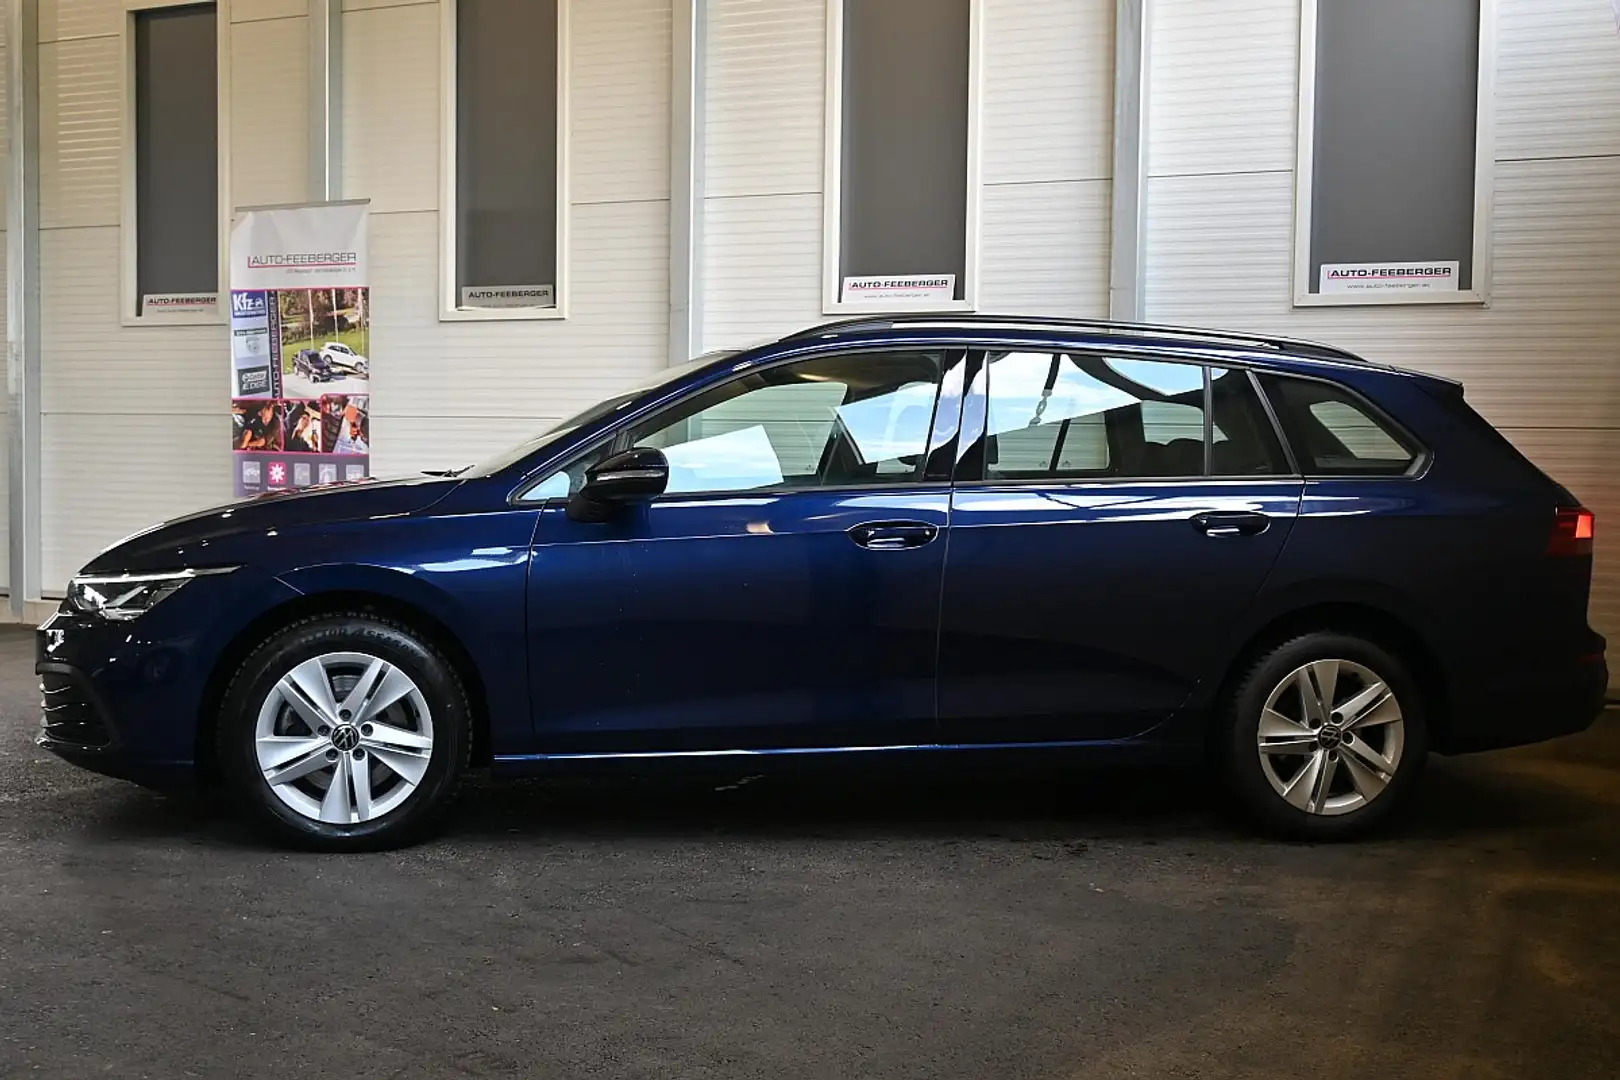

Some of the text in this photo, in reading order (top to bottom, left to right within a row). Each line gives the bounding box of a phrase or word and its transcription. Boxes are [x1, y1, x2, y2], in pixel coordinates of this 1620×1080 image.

[251, 252, 357, 265] AUTO-FEEBERGER
[1331, 267, 1452, 277] AUTO-FEEBERGER
[852, 279, 949, 289] AUTO-FEEBERGER
[468, 290, 549, 299] AUTO-FEEBERGER
